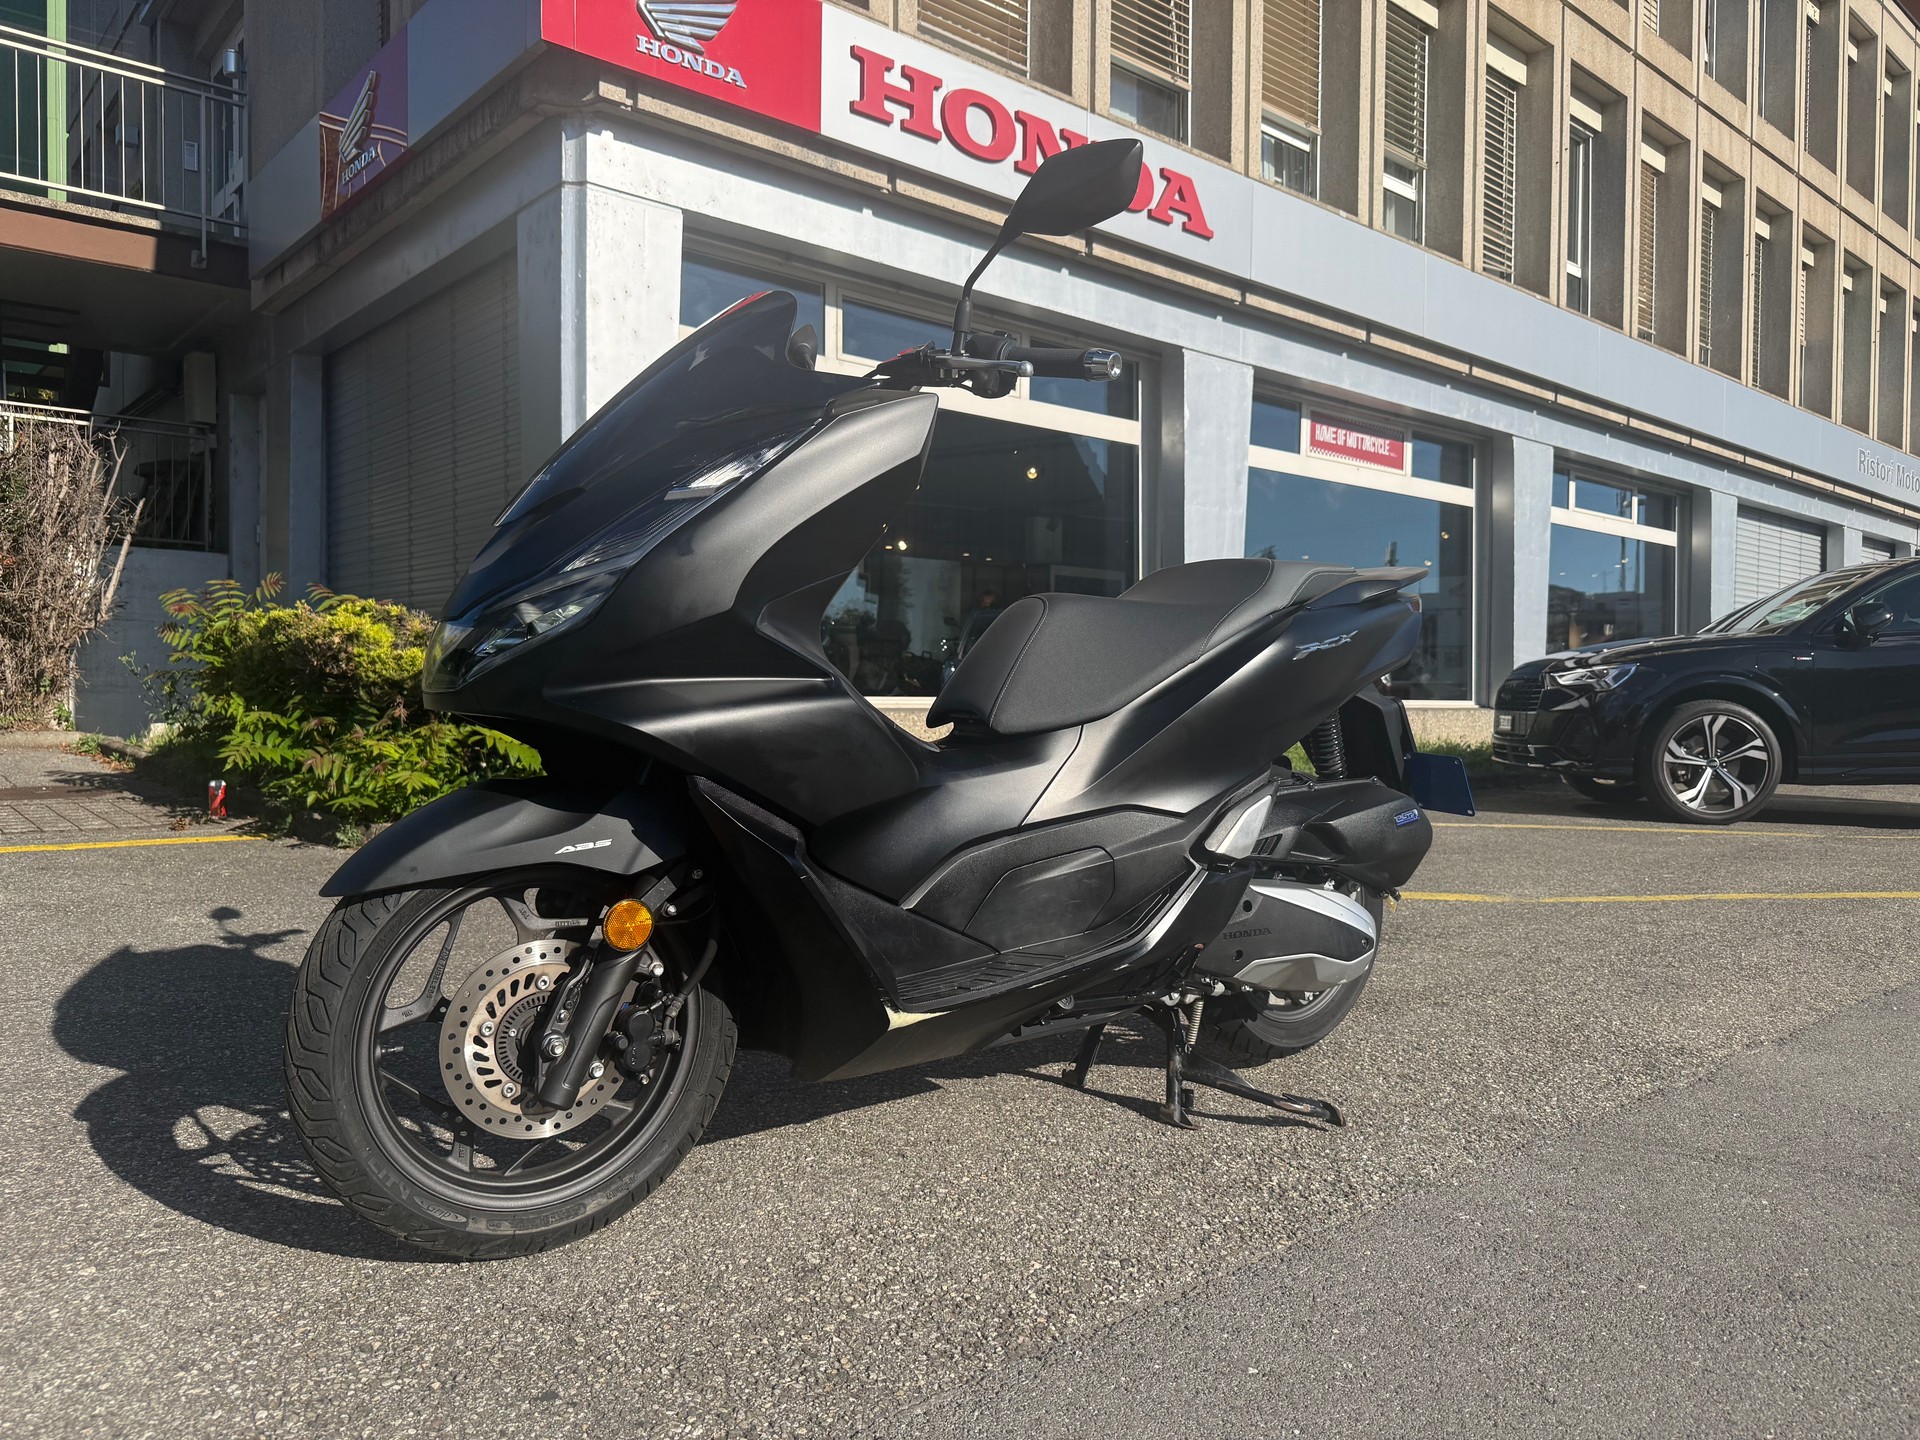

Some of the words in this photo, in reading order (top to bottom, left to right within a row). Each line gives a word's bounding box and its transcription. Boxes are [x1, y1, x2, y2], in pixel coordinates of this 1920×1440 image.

[635, 34, 748, 89] HONDA
[341, 146, 378, 184] HONDA
[1315, 423, 1337, 445] HOME
[1337, 428, 1345, 447] OF
[1858, 448, 1894, 484] Ristori
[554, 838, 613, 855] ABS
[1223, 927, 1272, 940] HONDA
